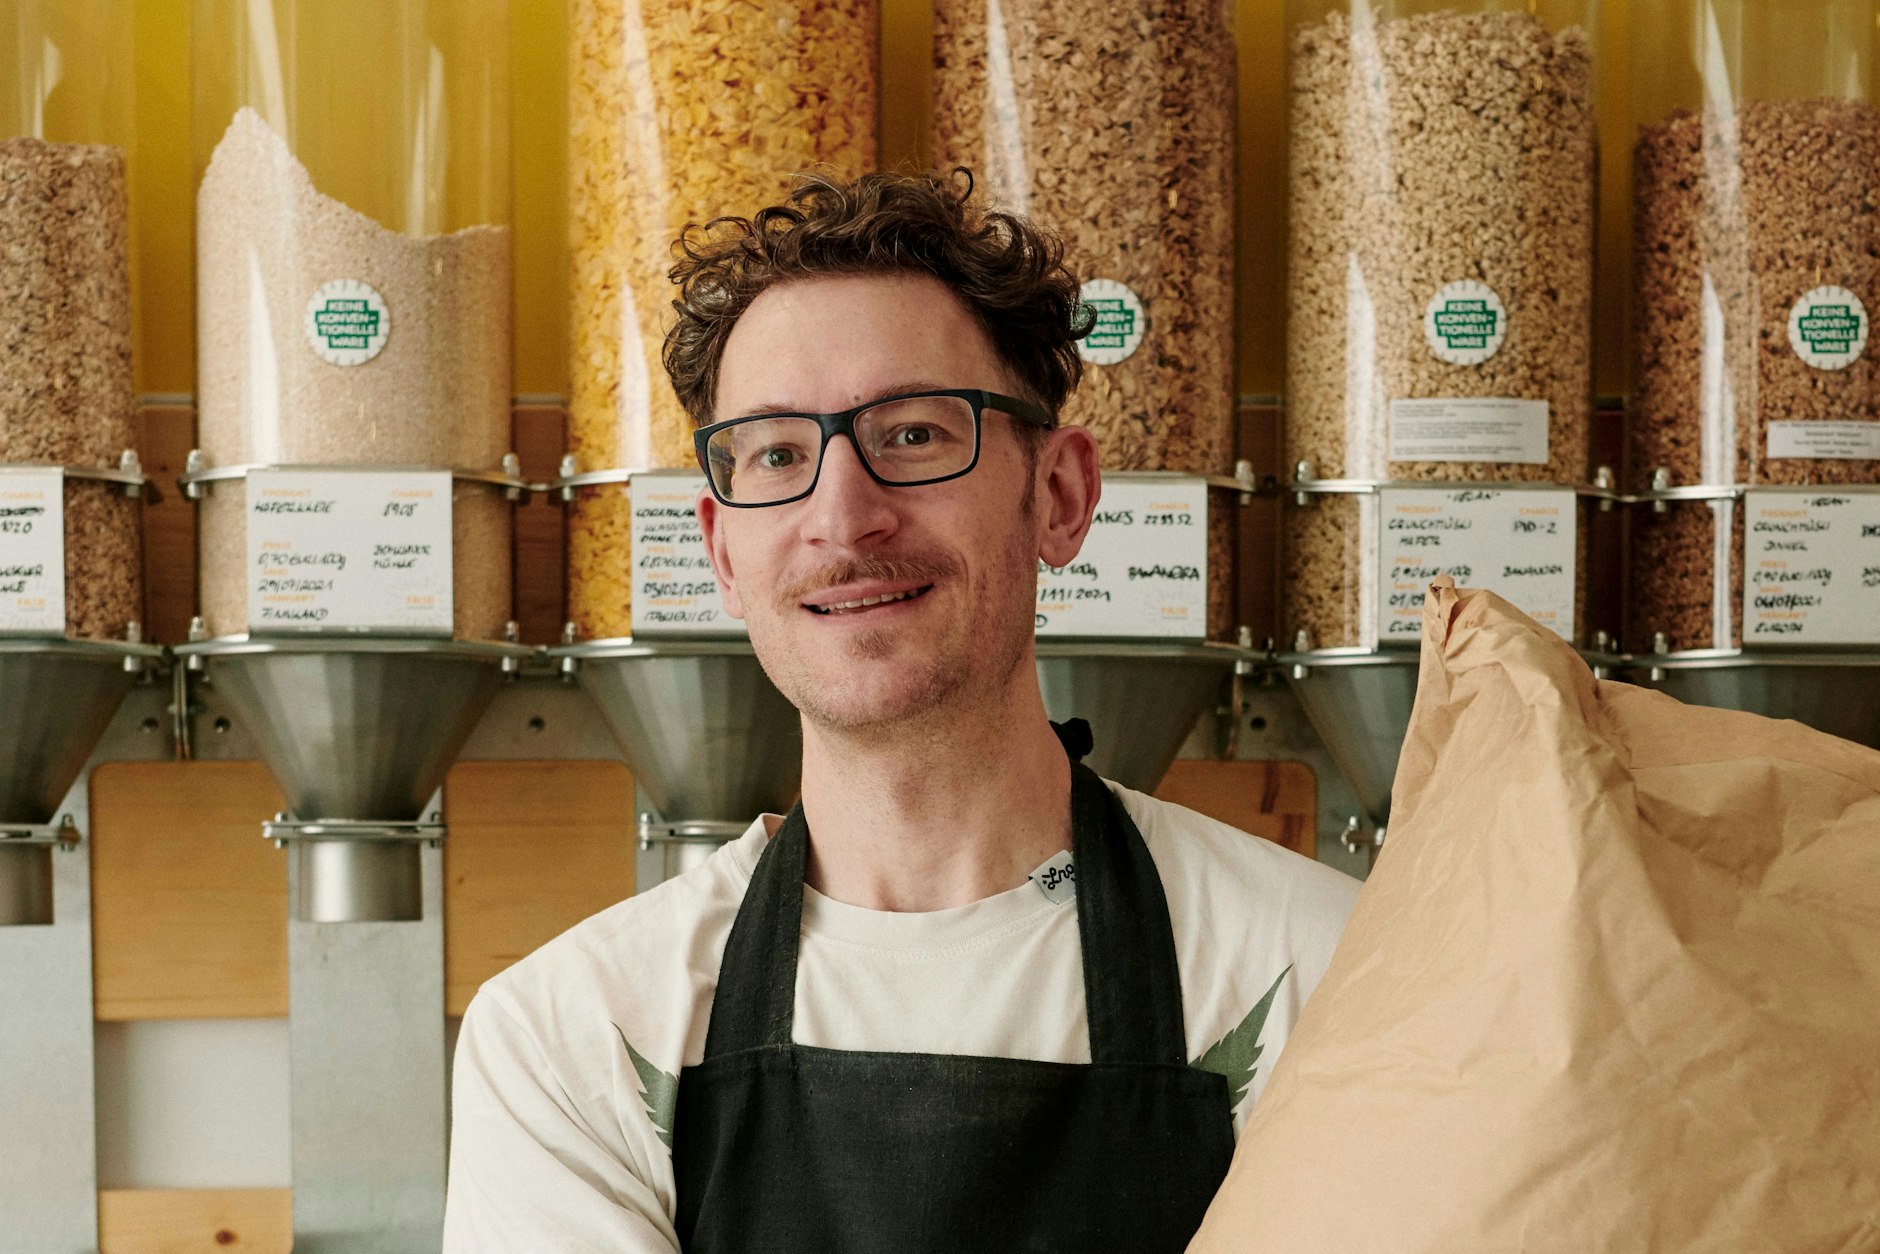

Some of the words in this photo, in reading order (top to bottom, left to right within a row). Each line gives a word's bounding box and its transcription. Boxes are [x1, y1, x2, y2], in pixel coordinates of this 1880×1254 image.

[328, 302, 365, 312] KEINE
[1448, 303, 1482, 312] KEINE
[318, 313, 377, 322] KONVEN-
[1812, 308, 1847, 317] KEINE
[1438, 313, 1494, 323] KONVEN-
[1802, 318, 1857, 328] KONVEN-
[320, 324, 376, 334] TIONELLE
[1440, 325, 1493, 335] TIONELLE
[1804, 330, 1856, 340] TIONELLE
[330, 336, 365, 347] WARE
[1087, 336, 1120, 346] WARE
[1450, 337, 1483, 346] WARE
[1814, 342, 1847, 351] WARE
